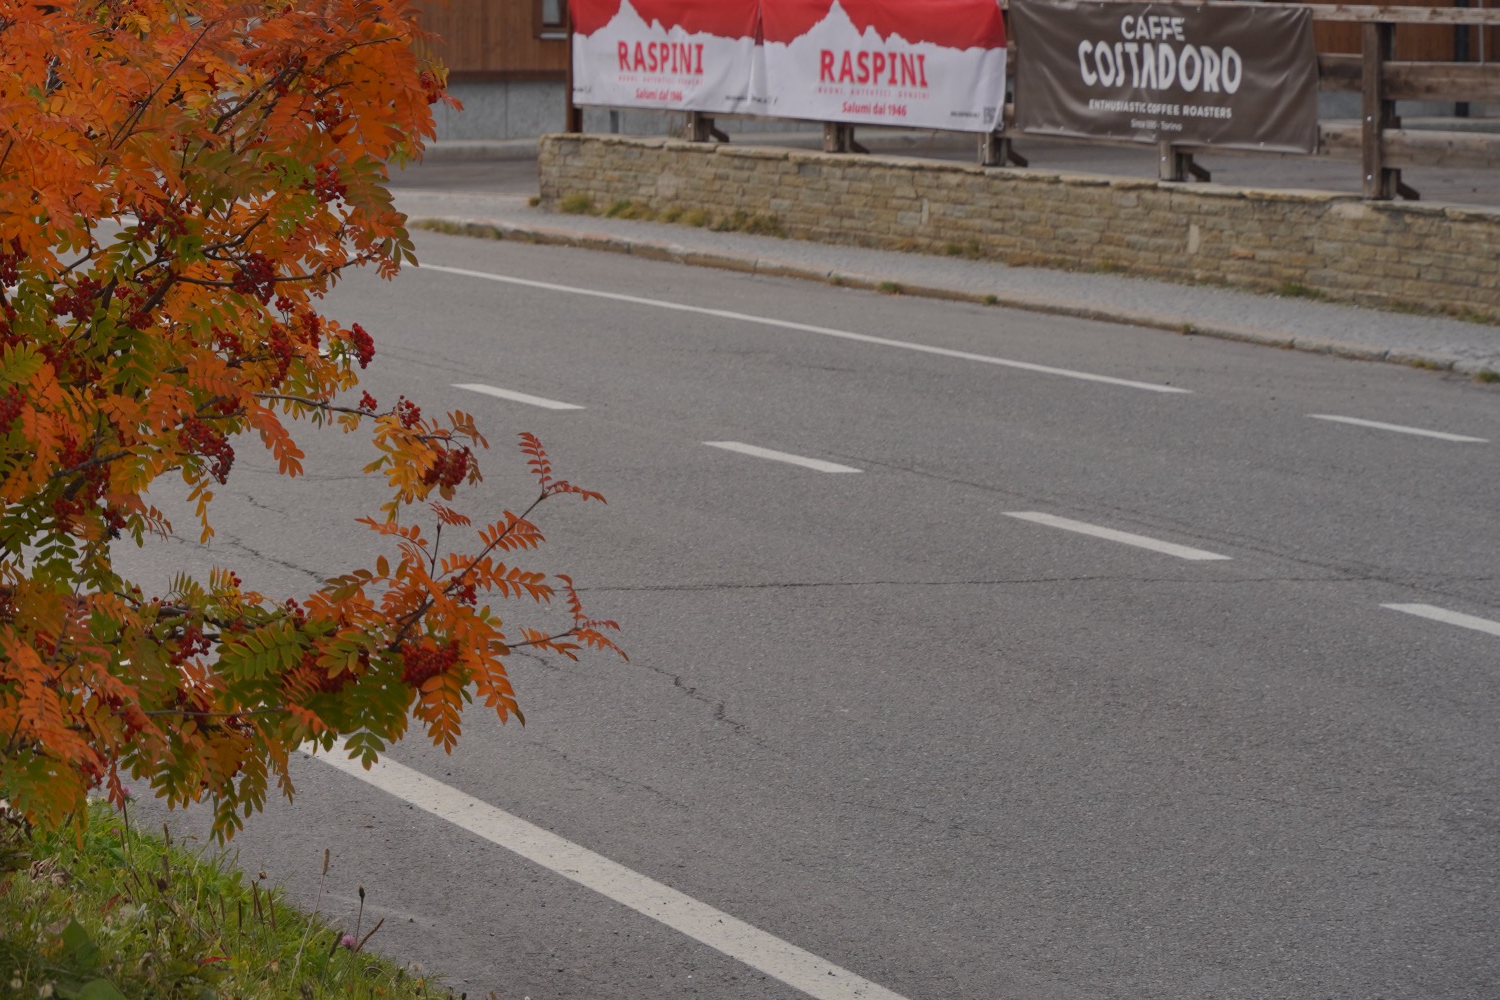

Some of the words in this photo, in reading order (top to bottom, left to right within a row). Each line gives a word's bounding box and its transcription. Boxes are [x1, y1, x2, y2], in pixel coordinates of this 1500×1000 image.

[617, 40, 704, 75] RASPINI
[820, 49, 928, 88] RASPINI
[1078, 39, 1242, 94] COSTADORO
[842, 101, 871, 115] Salumi
[873, 102, 886, 115] dal
[1089, 99, 1146, 114] ENTHUSIASTIC
[1147, 102, 1180, 116] COFFEE
[1182, 105, 1232, 119] ROASTERS
